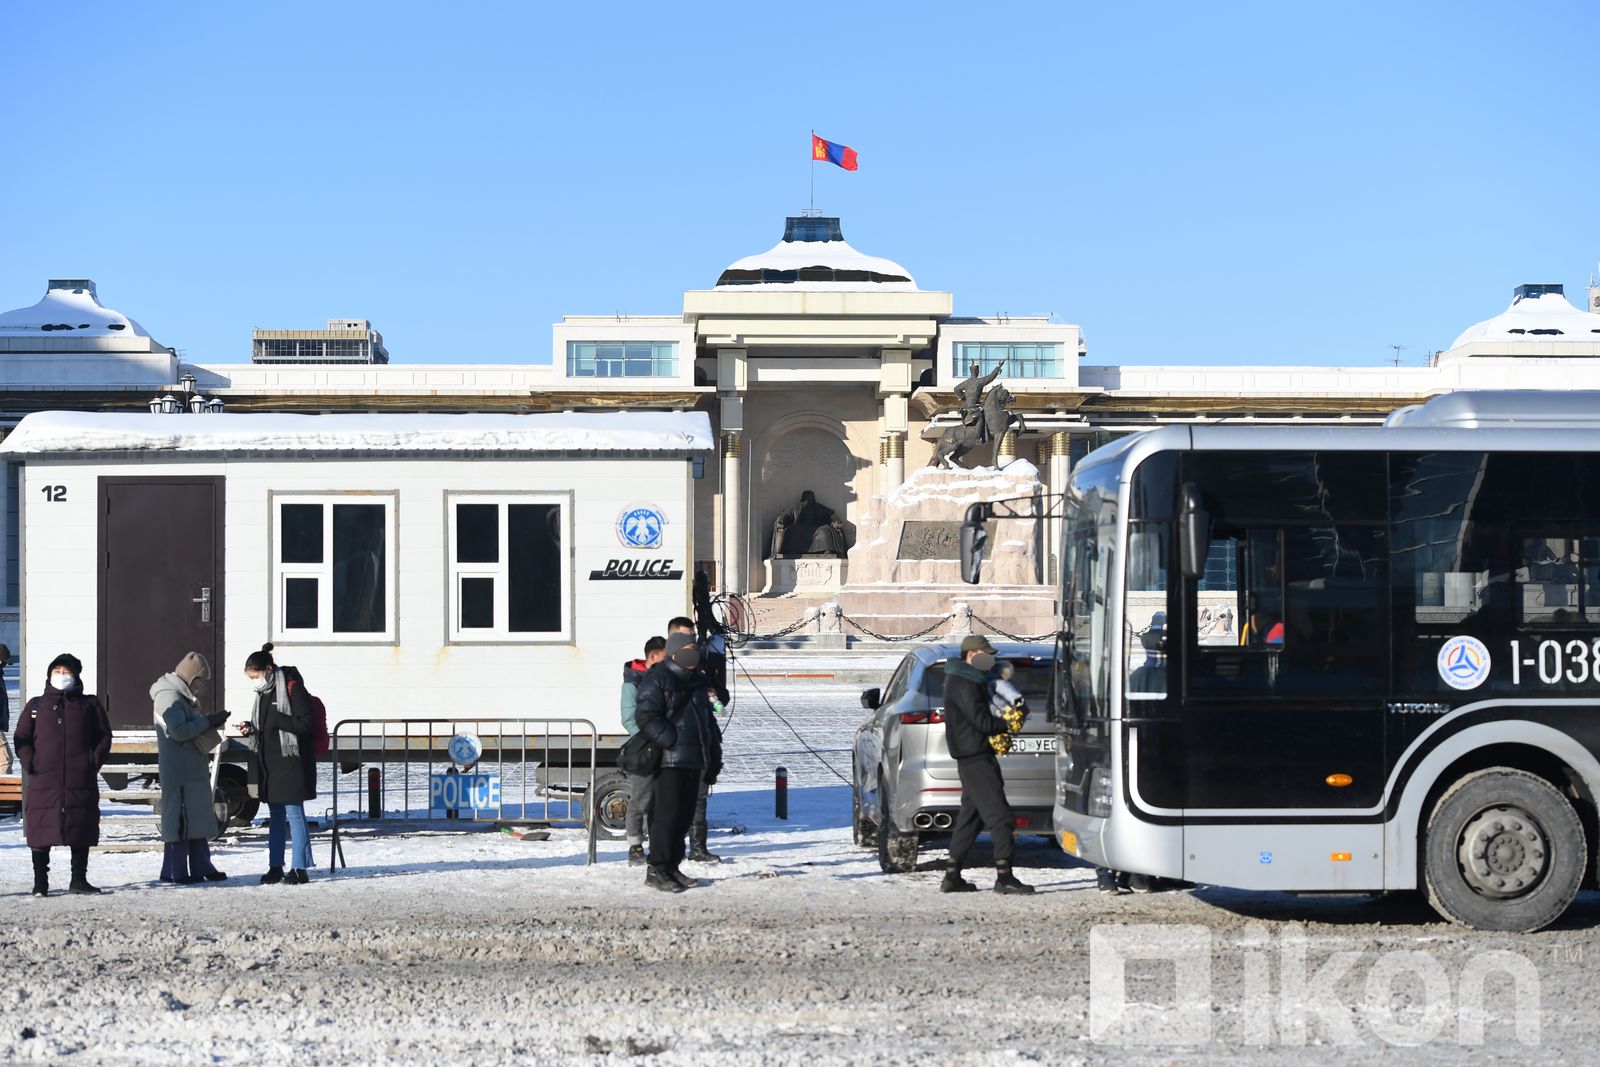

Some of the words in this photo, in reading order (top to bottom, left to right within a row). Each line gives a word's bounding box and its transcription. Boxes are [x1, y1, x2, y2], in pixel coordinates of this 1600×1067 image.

[41, 485, 67, 502] 12
[602, 559, 673, 577] POLICE
[1387, 702, 1450, 714] YUTONG
[431, 776, 501, 809] POLICE
